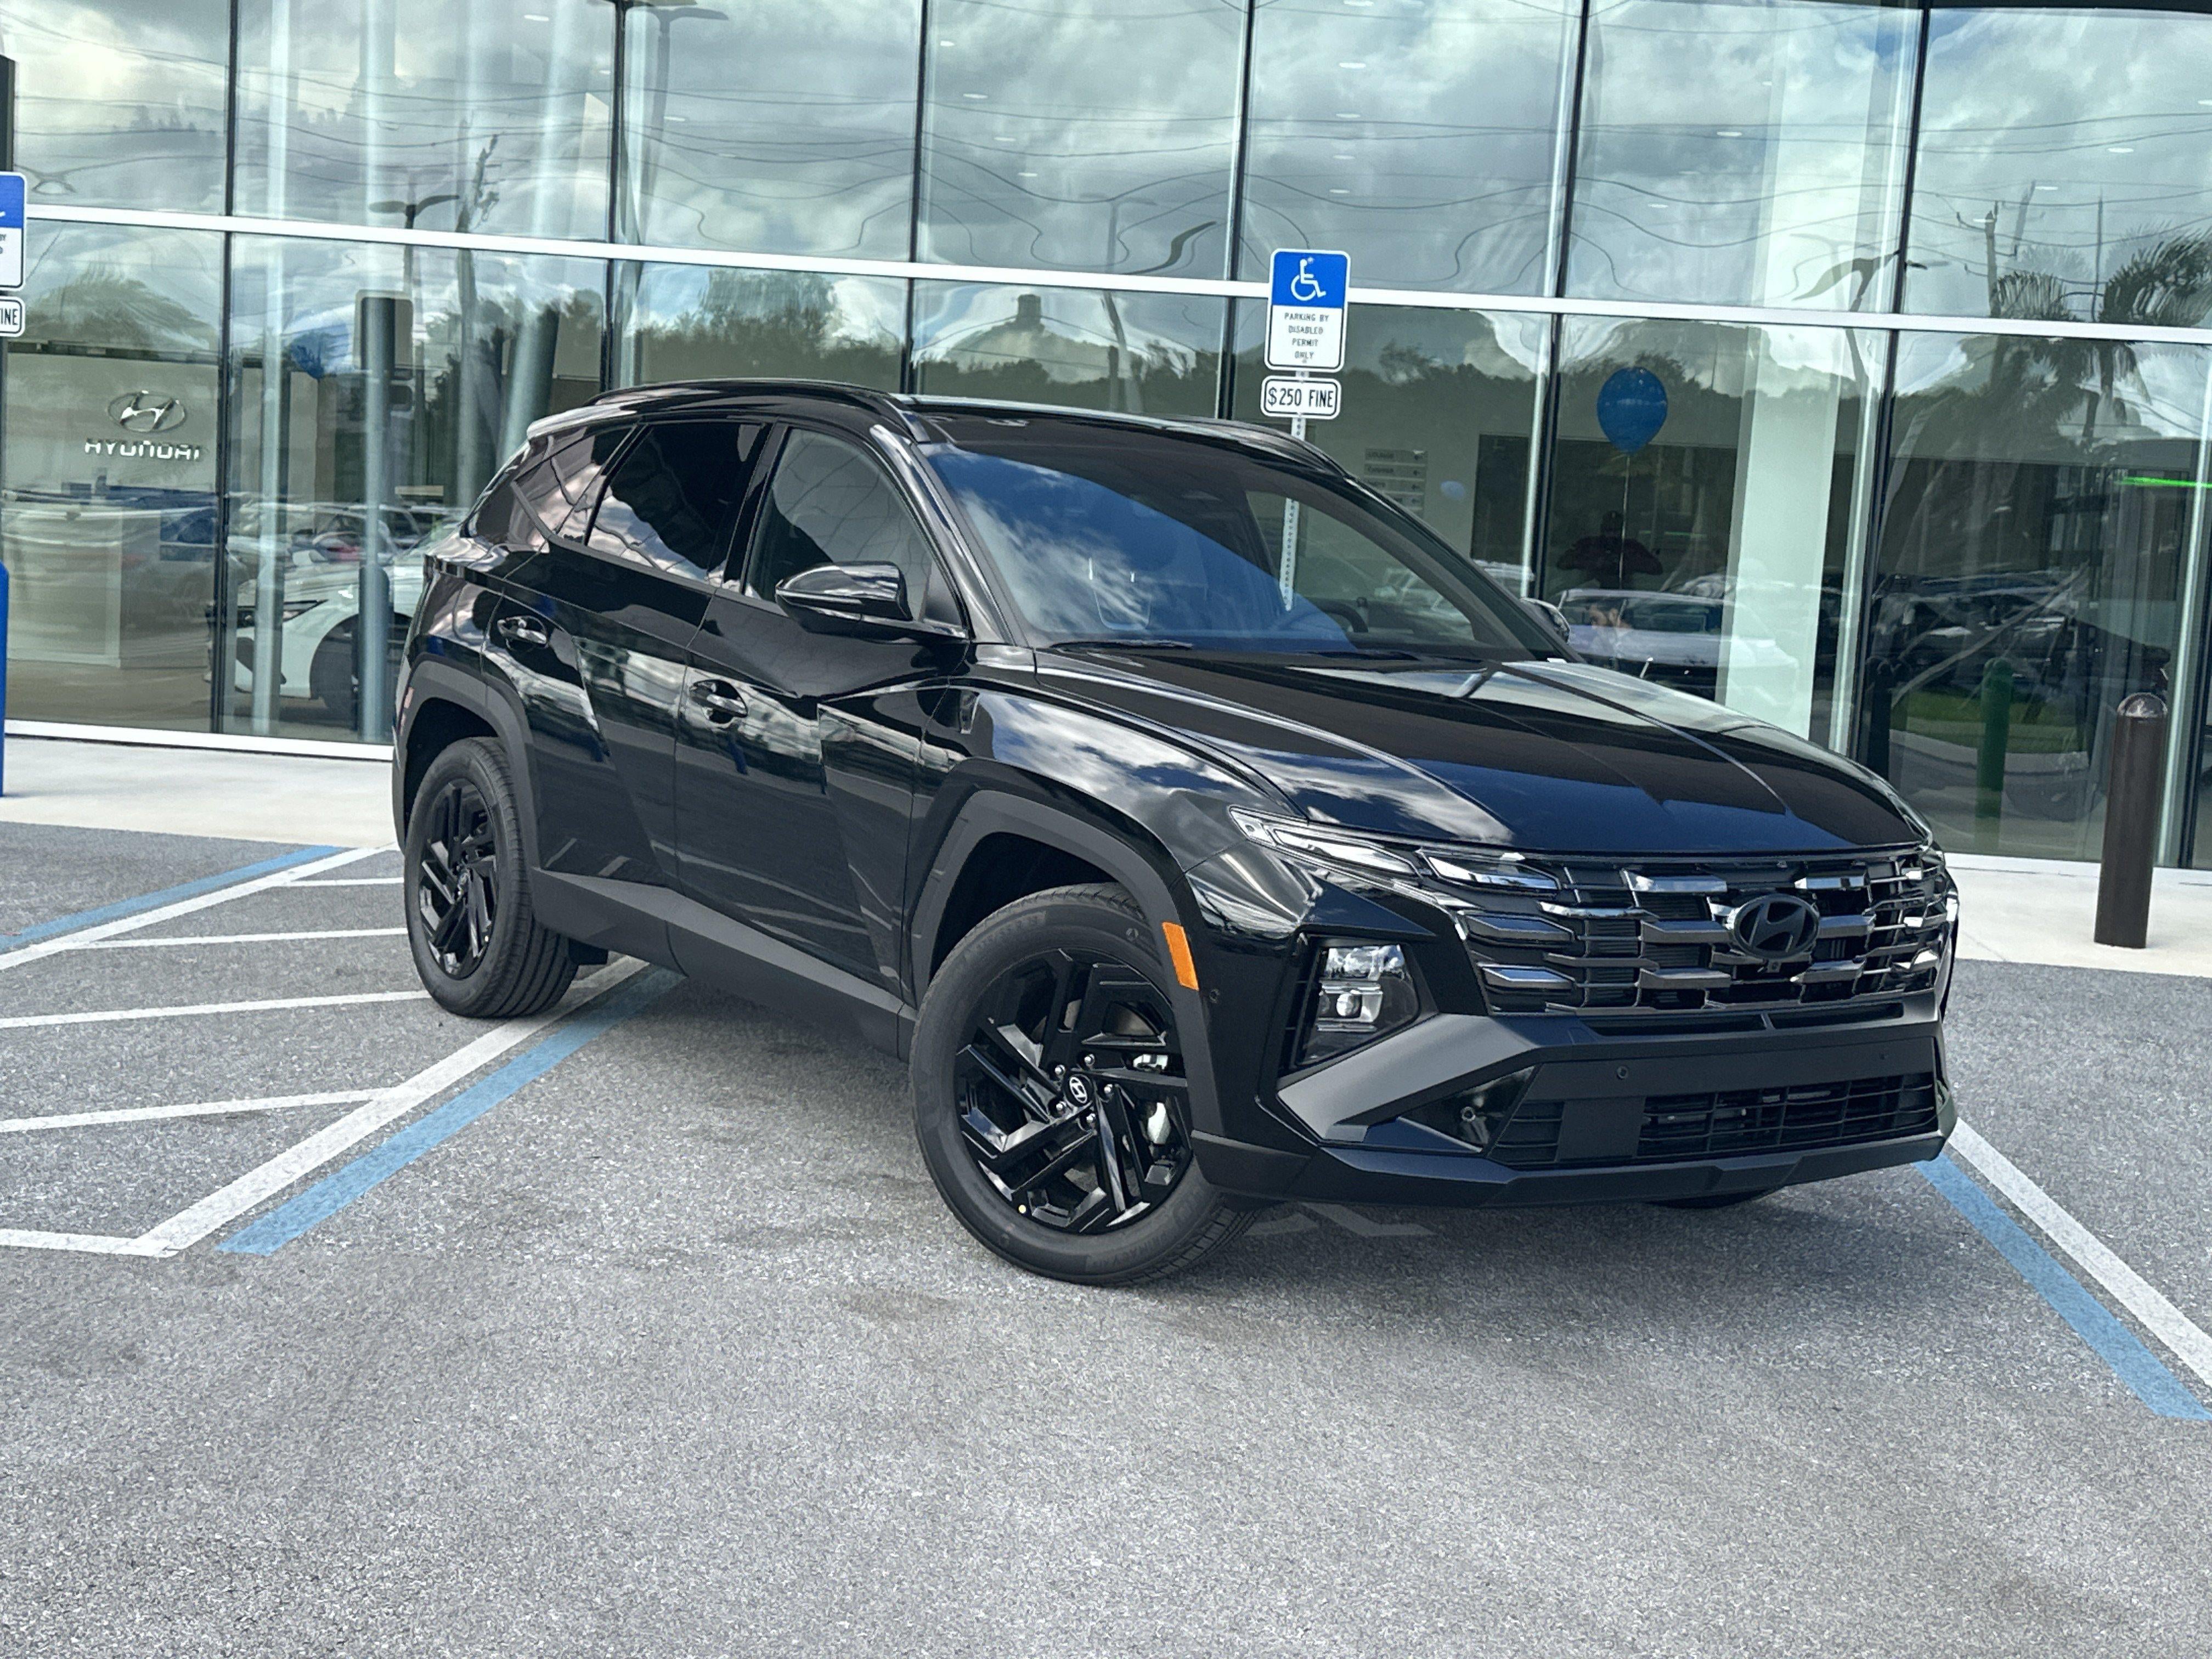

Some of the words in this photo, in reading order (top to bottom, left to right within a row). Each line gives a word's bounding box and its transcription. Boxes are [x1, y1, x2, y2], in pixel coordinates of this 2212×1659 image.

[0, 308, 19, 325] INE
[1284, 312, 1316, 321] PARKING
[1288, 325, 1324, 335] DISABLED
[1292, 338, 1318, 347] PERMIT
[1294, 351, 1314, 359] ONLY
[1267, 387, 1302, 407] $250
[1308, 390, 1334, 408] FINE
[84, 438, 201, 461] HYUNDAI
